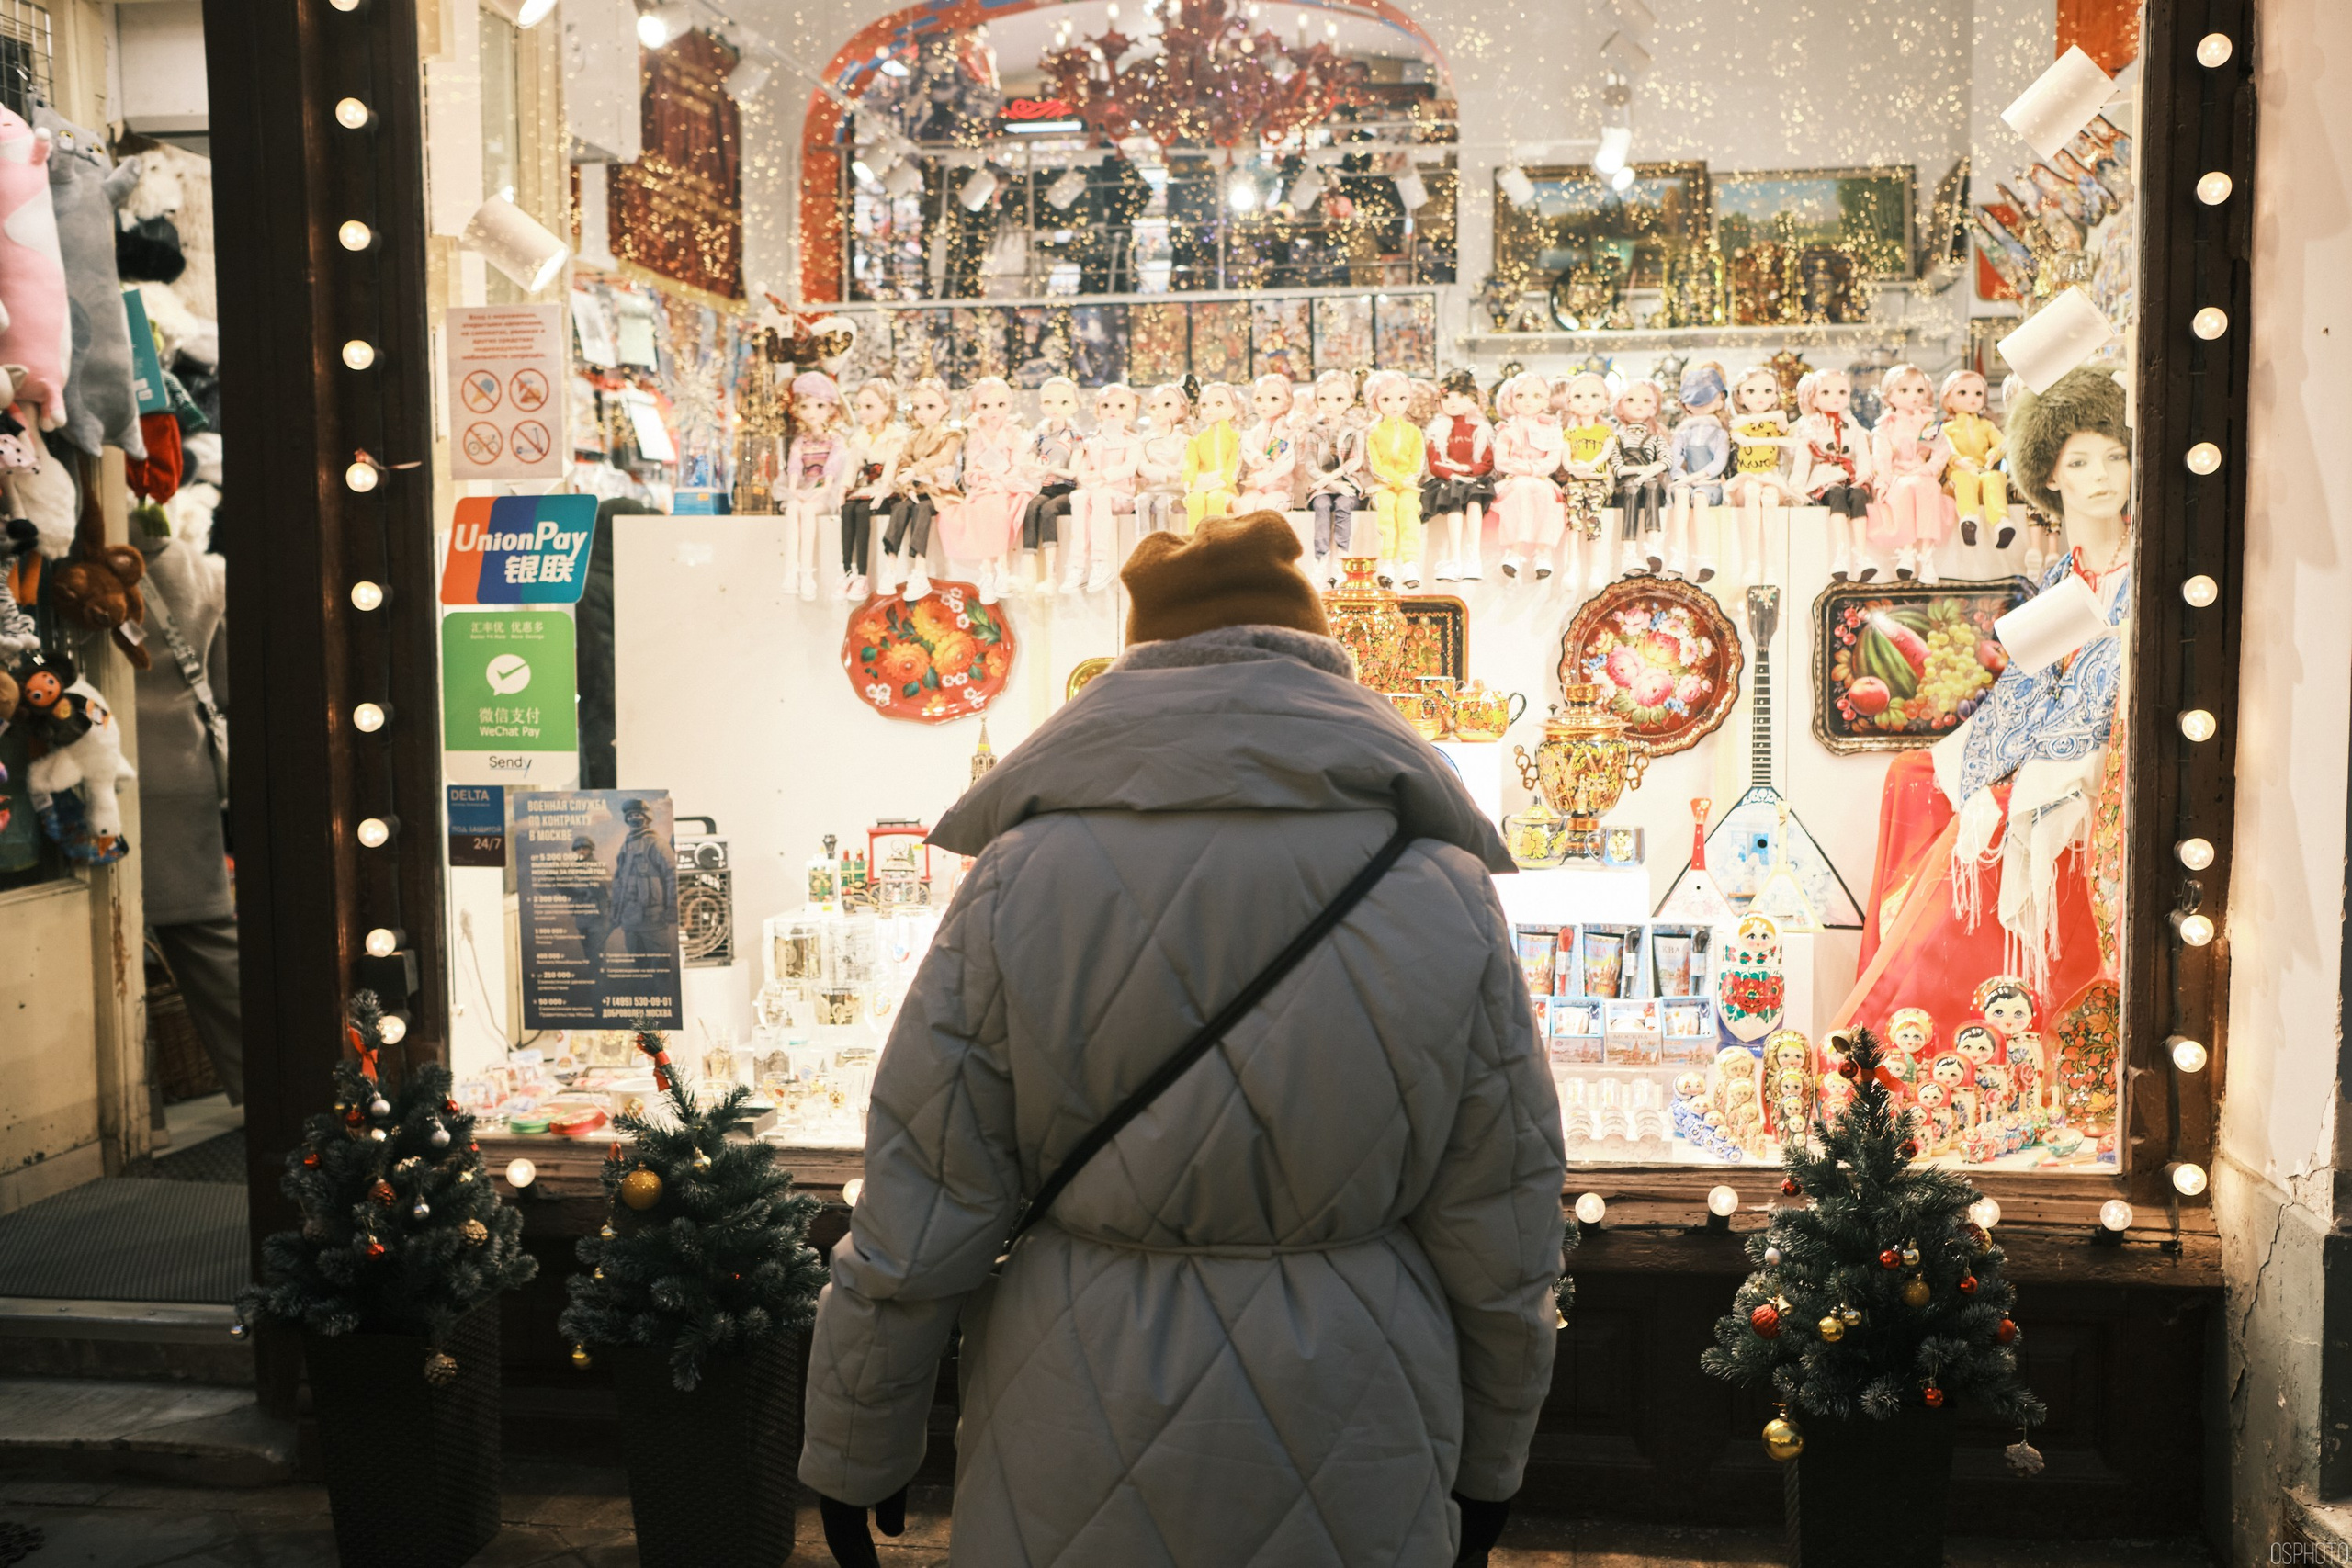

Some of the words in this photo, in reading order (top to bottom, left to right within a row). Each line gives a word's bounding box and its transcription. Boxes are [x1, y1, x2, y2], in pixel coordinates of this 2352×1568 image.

[454, 521, 588, 561] UnionPay
[504, 555, 575, 583] 银联
[470, 621, 504, 633] 汇率优
[511, 621, 544, 633] 优惠多
[479, 707, 540, 725] 微信支付
[480, 726, 519, 737] WeChat
[522, 726, 540, 739] Pay
[451, 789, 490, 801] DELTA
[527, 800, 567, 812] ВОЕННАЯ
[570, 799, 607, 811] СЛУЖБА
[528, 815, 540, 827] ПО
[542, 814, 592, 826] КОНТРАКТУ
[528, 830, 536, 841] В
[537, 829, 572, 841] МОСКВЕ
[474, 838, 502, 851] 24/7
[602, 997, 610, 1006] +7
